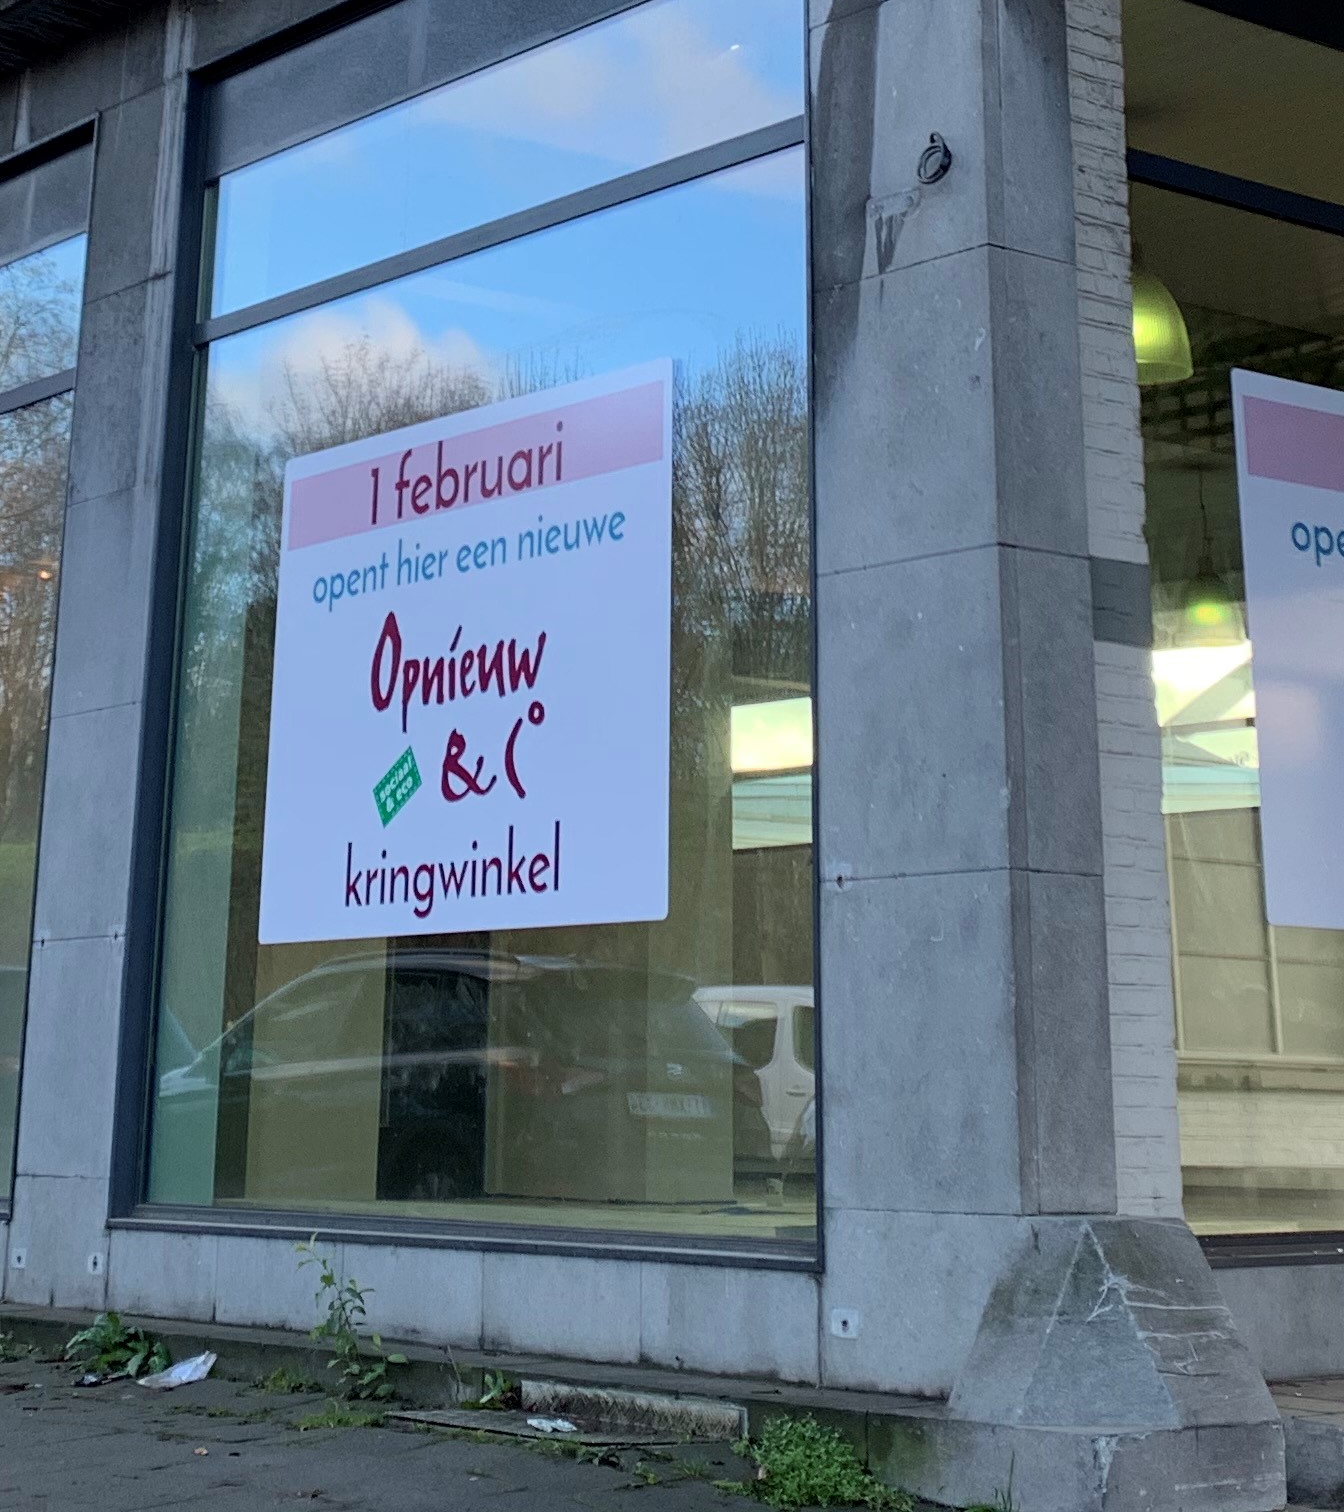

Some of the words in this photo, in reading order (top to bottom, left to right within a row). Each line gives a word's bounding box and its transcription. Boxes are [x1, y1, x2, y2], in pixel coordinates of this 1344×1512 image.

[371, 467, 381, 526] 1
[394, 420, 564, 520] februari
[312, 551, 390, 613] opent
[396, 538, 449, 586] hier
[455, 536, 507, 574] een
[517, 511, 626, 561] nieuwe
[370, 610, 547, 734] Opnieuw
[379, 754, 413, 804] sociaal
[395, 775, 413, 802] eco
[344, 820, 561, 919] kringwinkel
